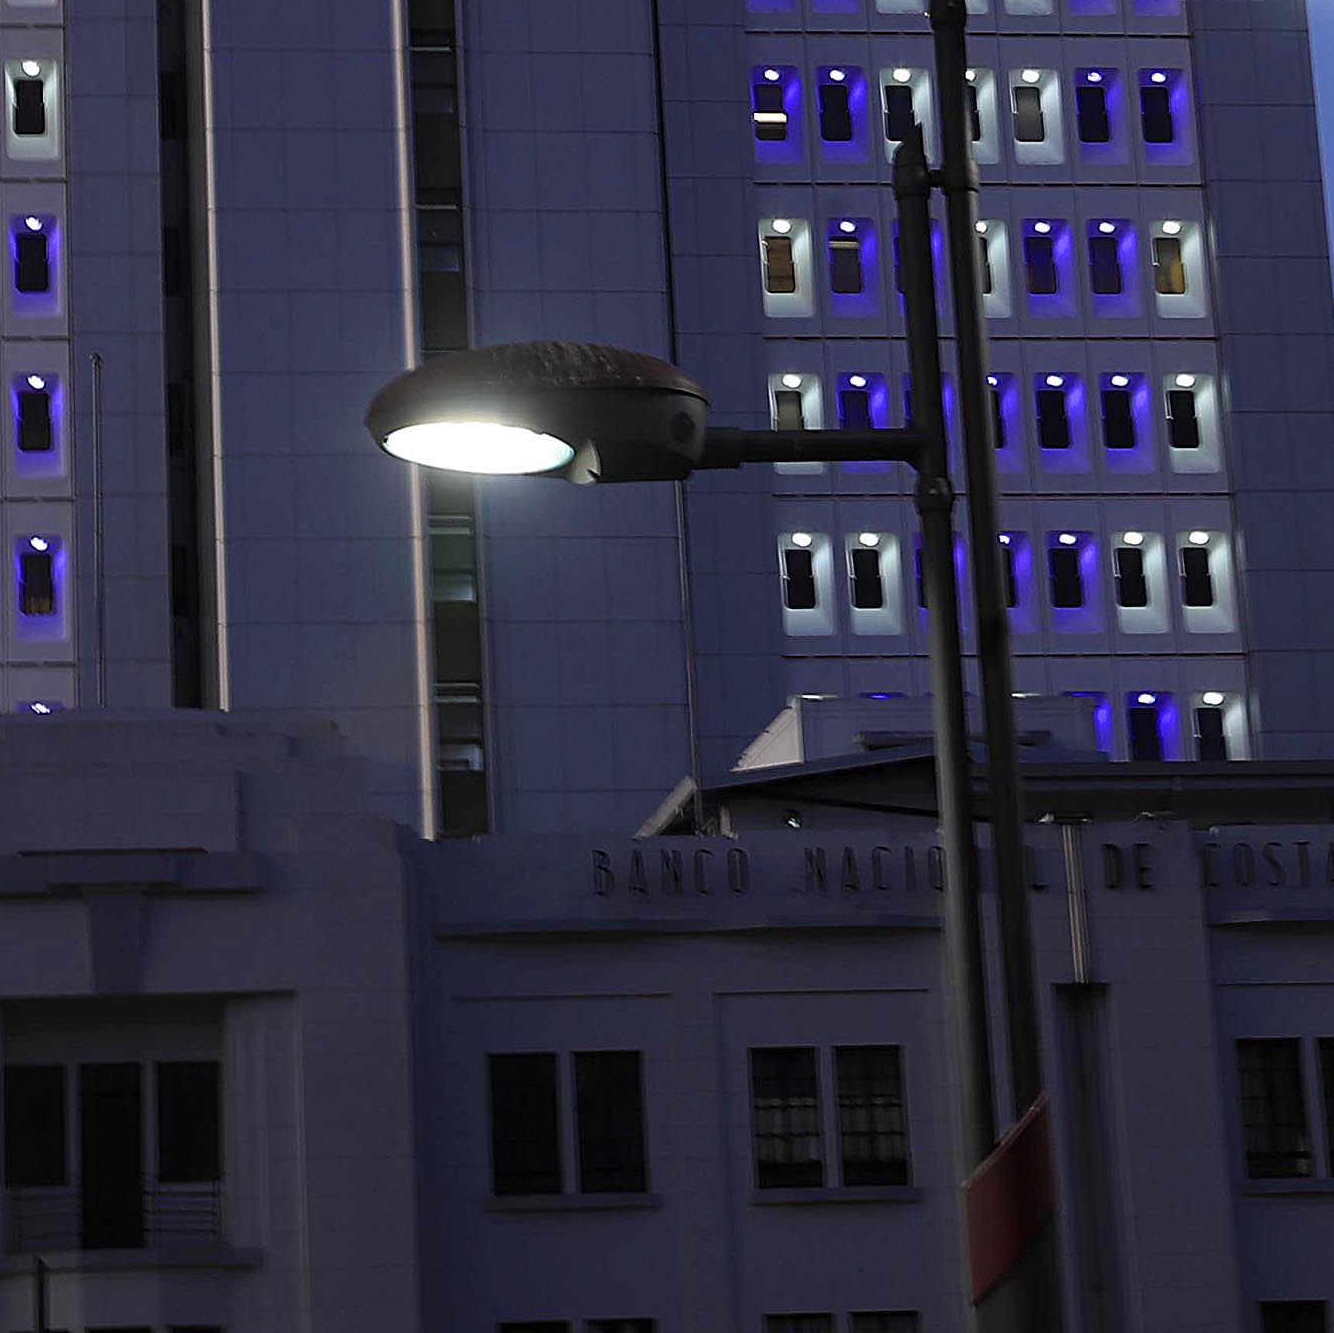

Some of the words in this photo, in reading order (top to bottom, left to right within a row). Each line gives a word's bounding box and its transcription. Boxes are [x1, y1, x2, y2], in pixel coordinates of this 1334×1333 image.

[593, 849, 750, 897] BANCO
[803, 844, 1049, 892] NACIOL
[1102, 842, 1156, 890] DE
